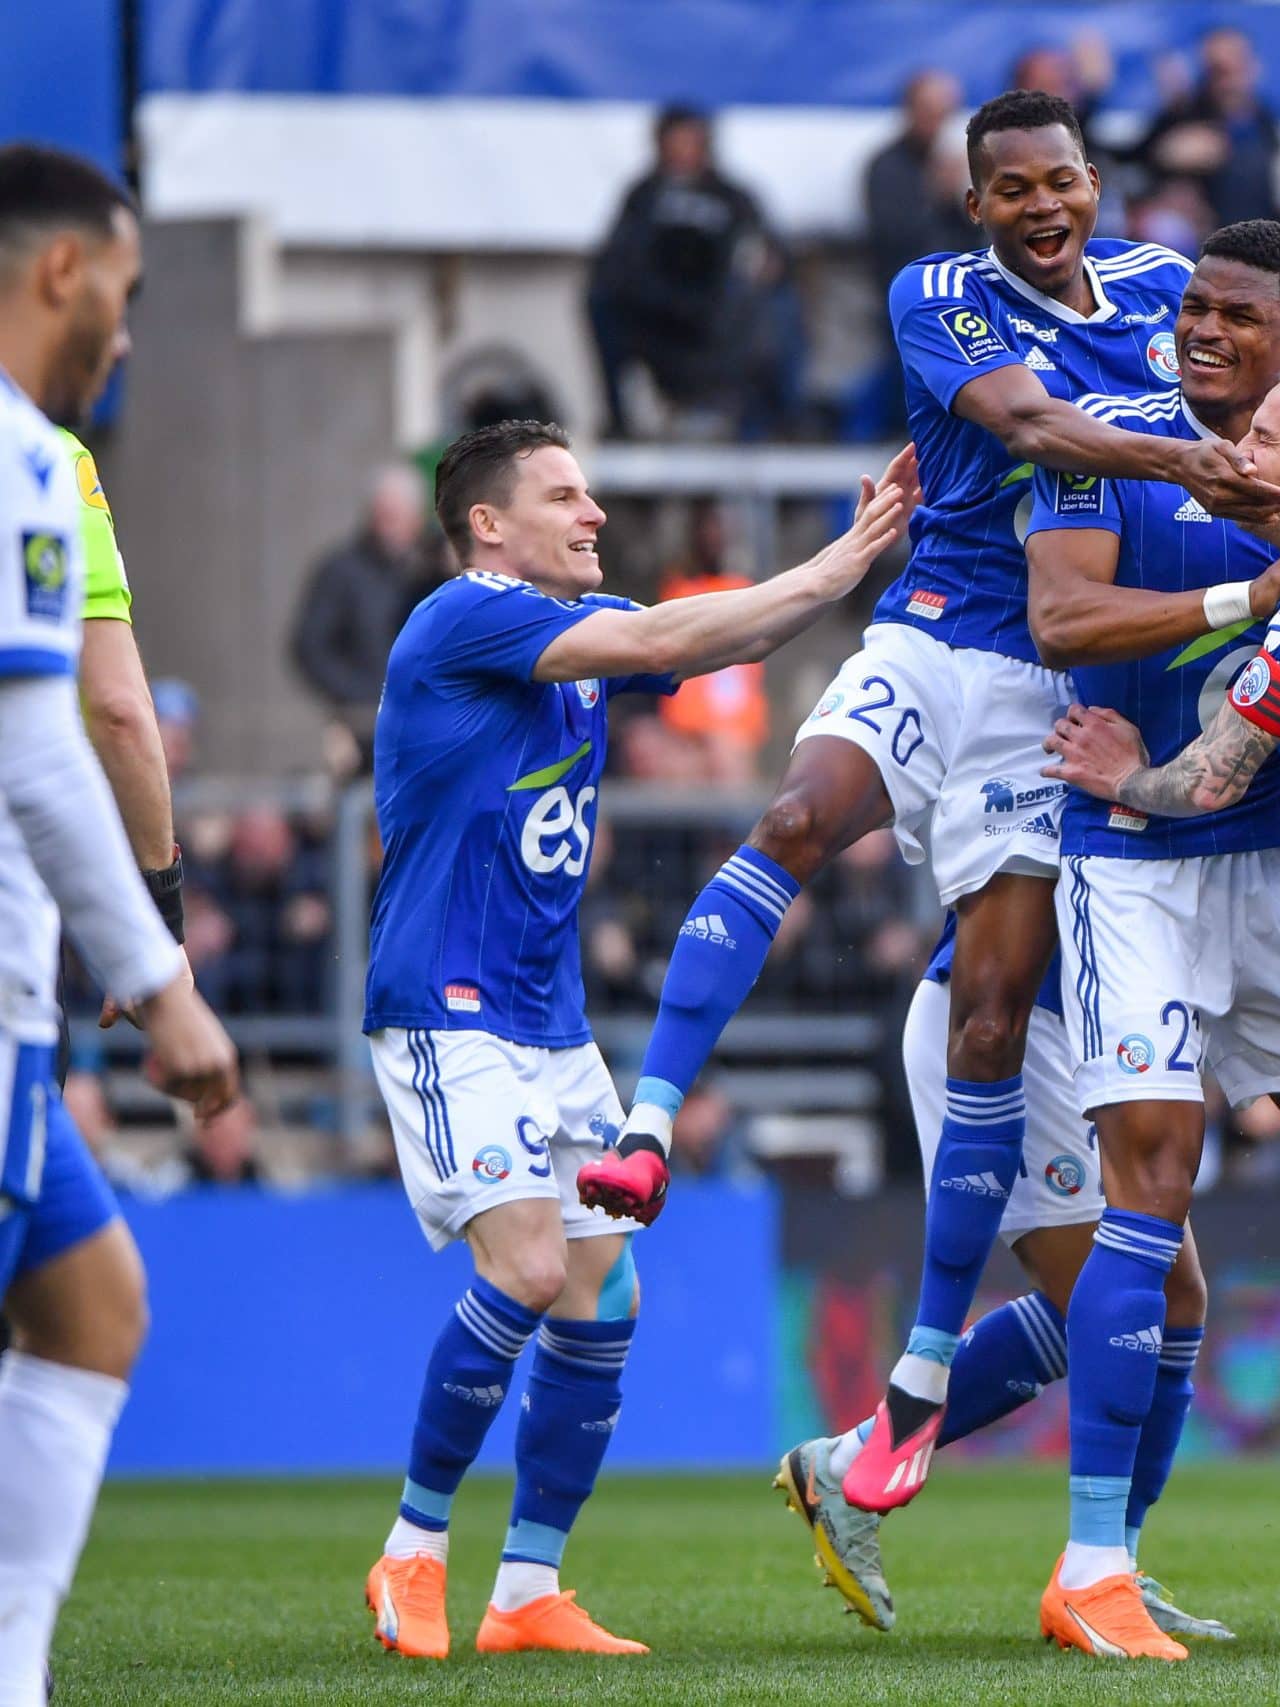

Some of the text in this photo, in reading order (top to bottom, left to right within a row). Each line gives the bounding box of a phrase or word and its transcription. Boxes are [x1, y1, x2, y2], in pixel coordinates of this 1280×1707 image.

[1007, 313, 1060, 343] haer
[1060, 502, 1097, 511] Uber Eats
[1174, 511, 1214, 524] adidas
[847, 675, 925, 767] 20
[939, 1179, 1010, 1200] adidas
